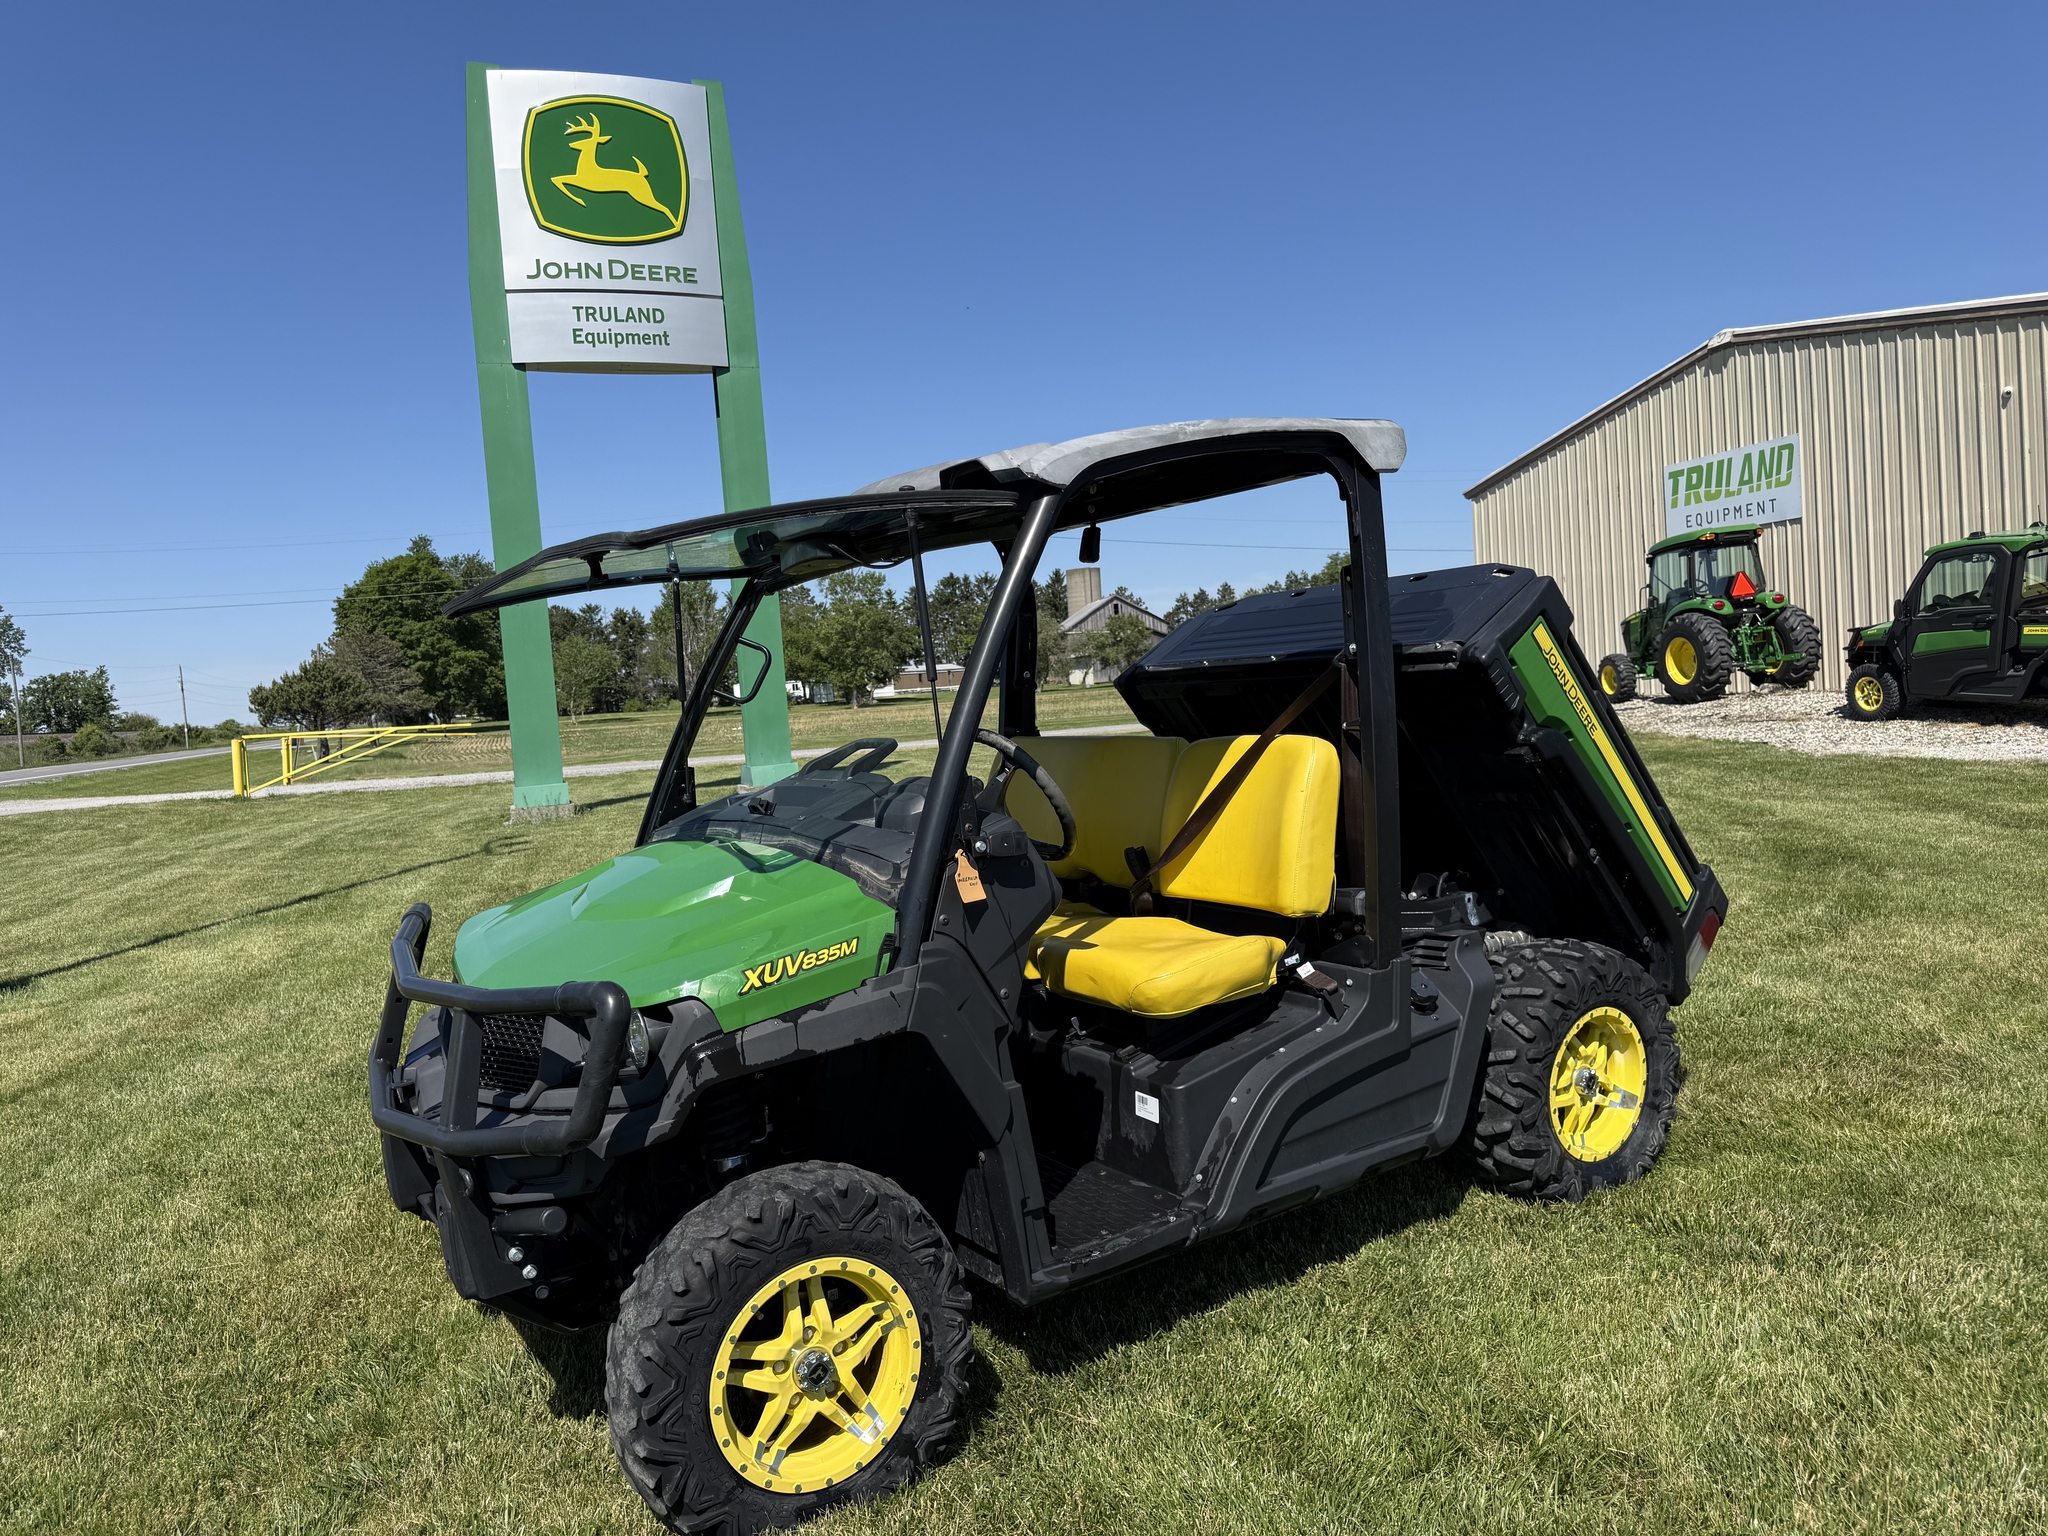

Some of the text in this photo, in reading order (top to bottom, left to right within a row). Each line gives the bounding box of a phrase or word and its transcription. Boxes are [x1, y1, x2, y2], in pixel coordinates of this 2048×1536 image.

[526, 259, 698, 284] JOHN DEERE
[572, 306, 665, 324] TRULAND
[572, 328, 670, 348] Equipment
[1668, 443, 1795, 509] TRULAND
[1685, 498, 1777, 528] EQUIPMENT
[1542, 647, 1598, 736] JOHN DEERE
[740, 937, 859, 995] XUV835M
